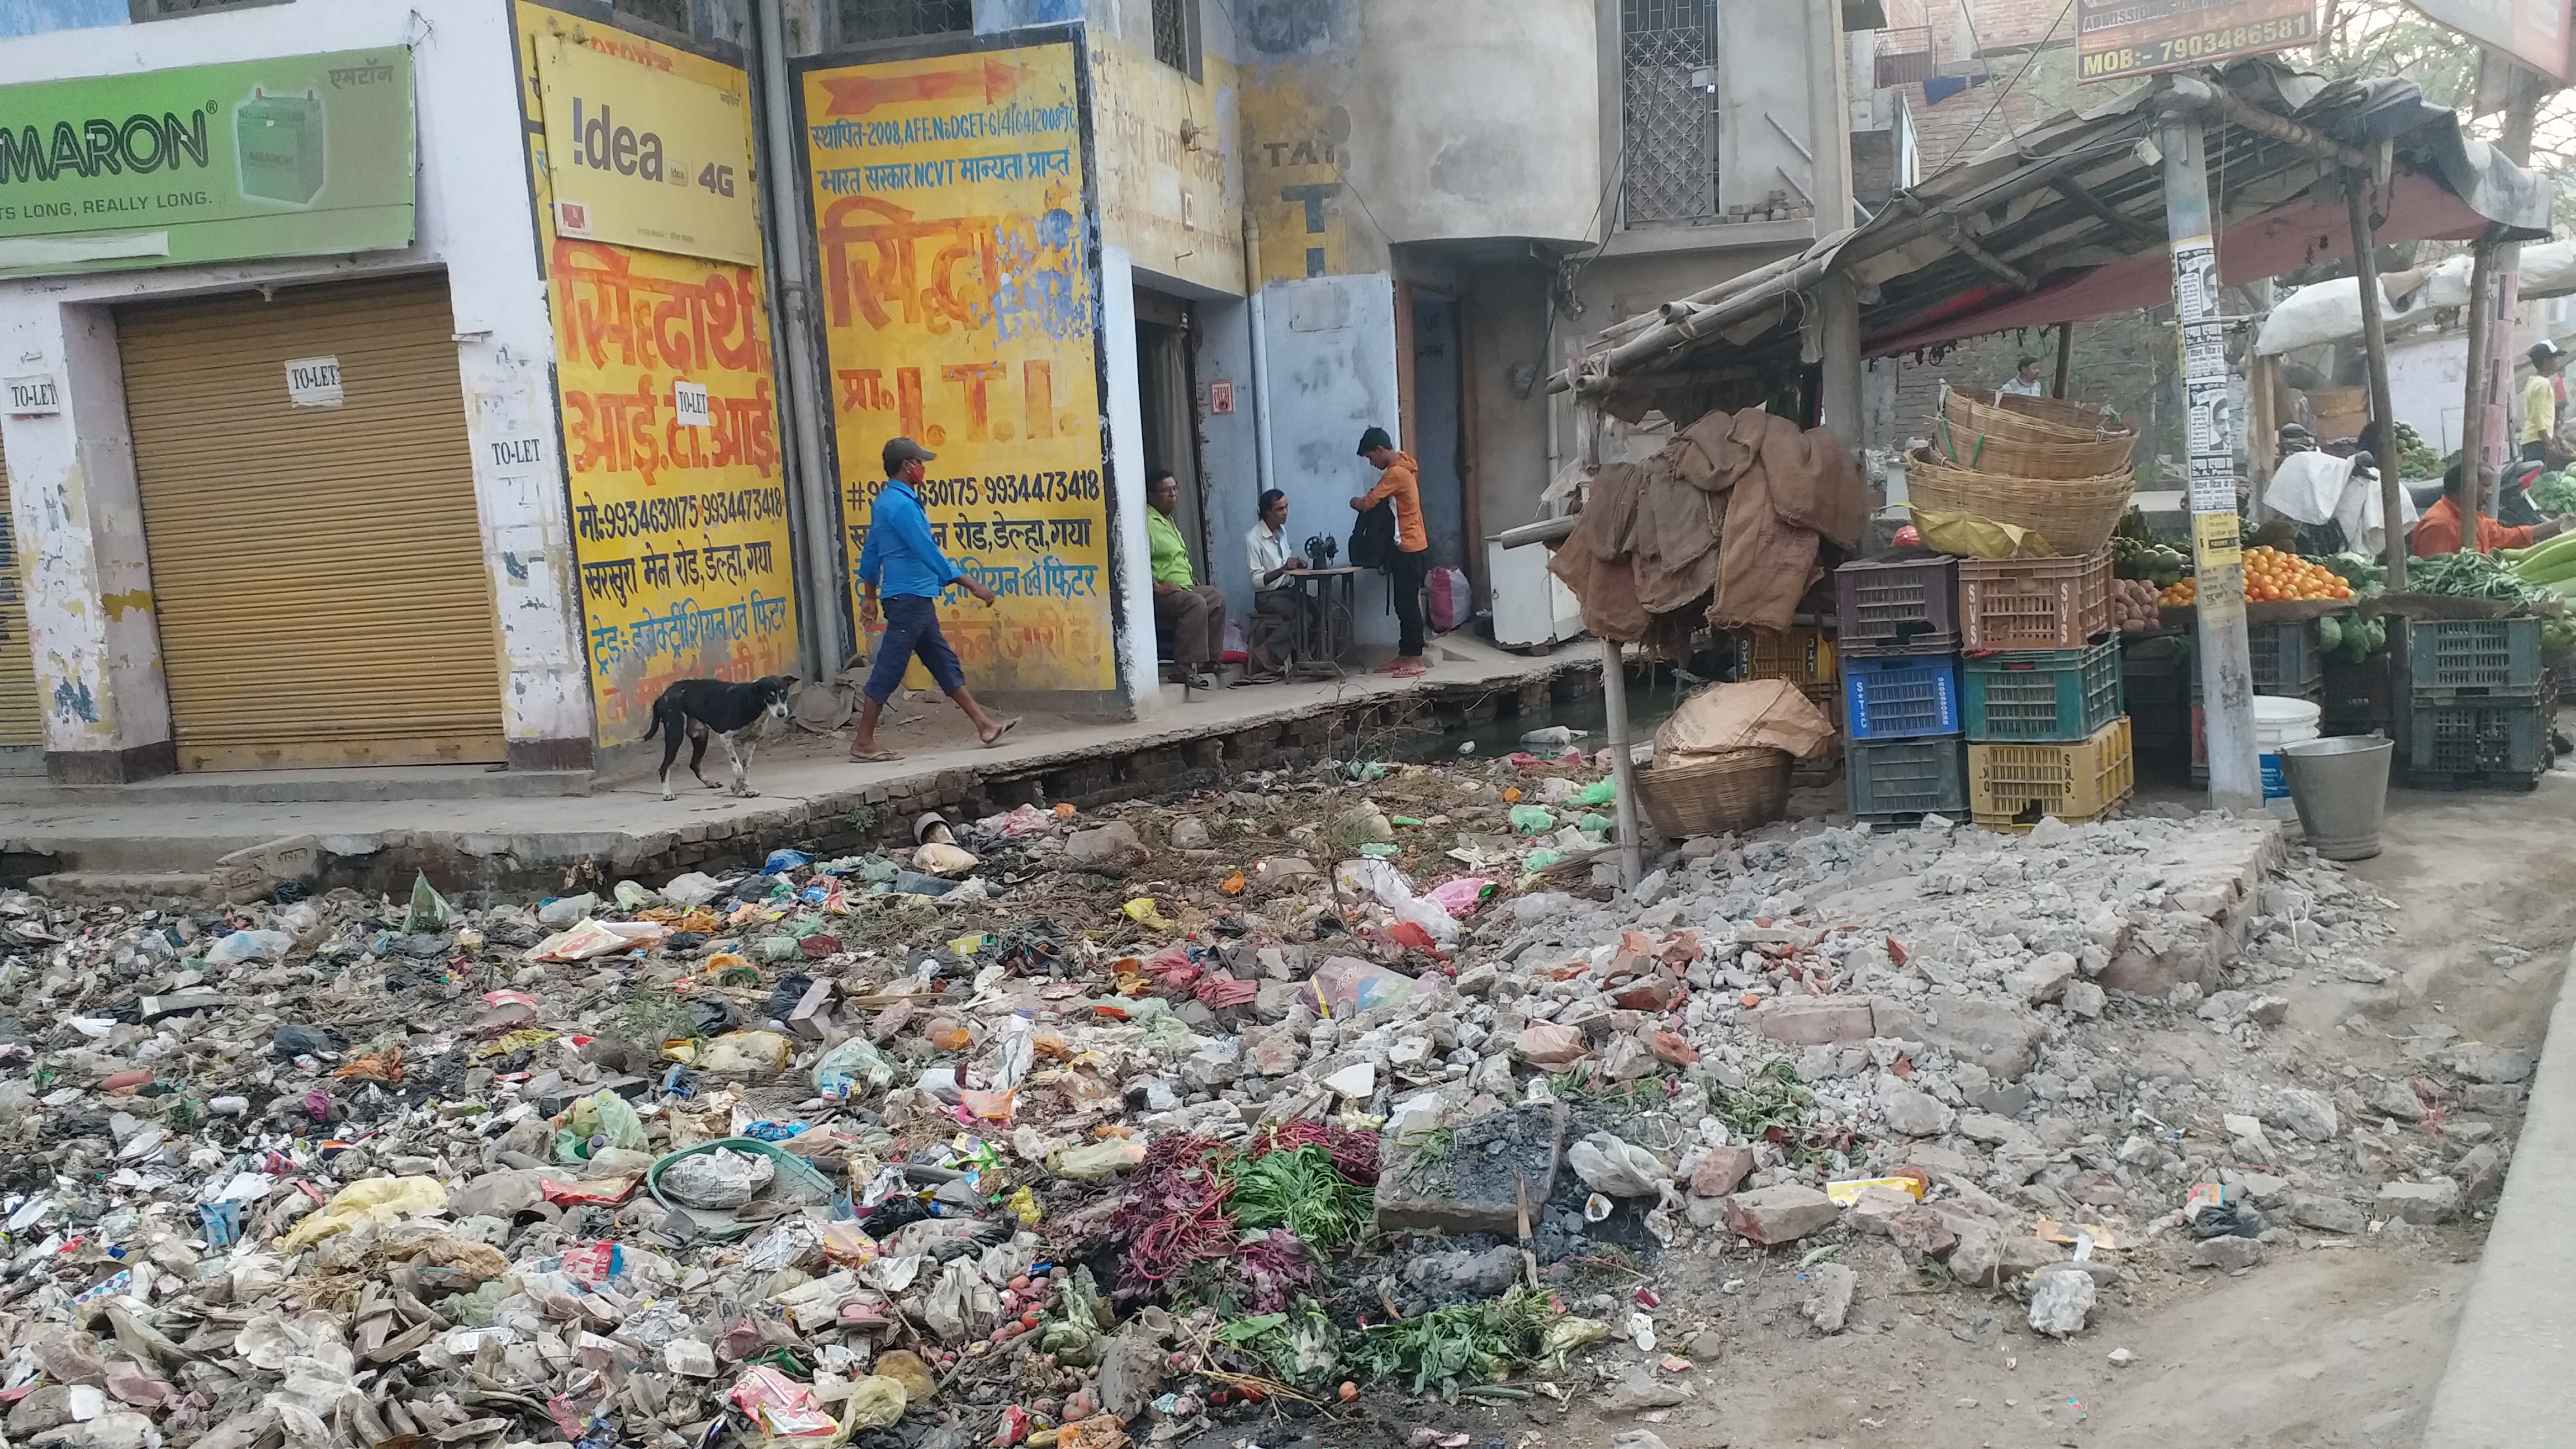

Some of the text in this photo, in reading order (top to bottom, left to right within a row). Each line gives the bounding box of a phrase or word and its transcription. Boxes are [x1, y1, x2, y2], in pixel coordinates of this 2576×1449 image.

[2083, 49, 2151, 75] MOB:-
[2160, 16, 2306, 61] 7903486581
[328, 58, 394, 89] एमरॉन
[698, 162, 734, 198] 4G
[817, 167, 861, 195] भारत
[914, 159, 956, 188] NCVT
[959, 153, 1024, 183] मान्यता
[1026, 149, 1071, 179] प्राप्त
[23, 202, 77, 218] LONG,
[83, 196, 148, 214] REALLY
[157, 191, 212, 208] LONG.
[292, 364, 337, 390] TO-LET
[12, 383, 56, 407] TO-LET
[679, 391, 707, 415] TO-LET
[897, 359, 1081, 446] I.T.I.
[491, 439, 541, 465] TO-LET
[1049, 519, 1092, 548] गया
[641, 541, 670, 591] मेन
[745, 540, 773, 575] गया
[750, 589, 787, 637] फिटर
